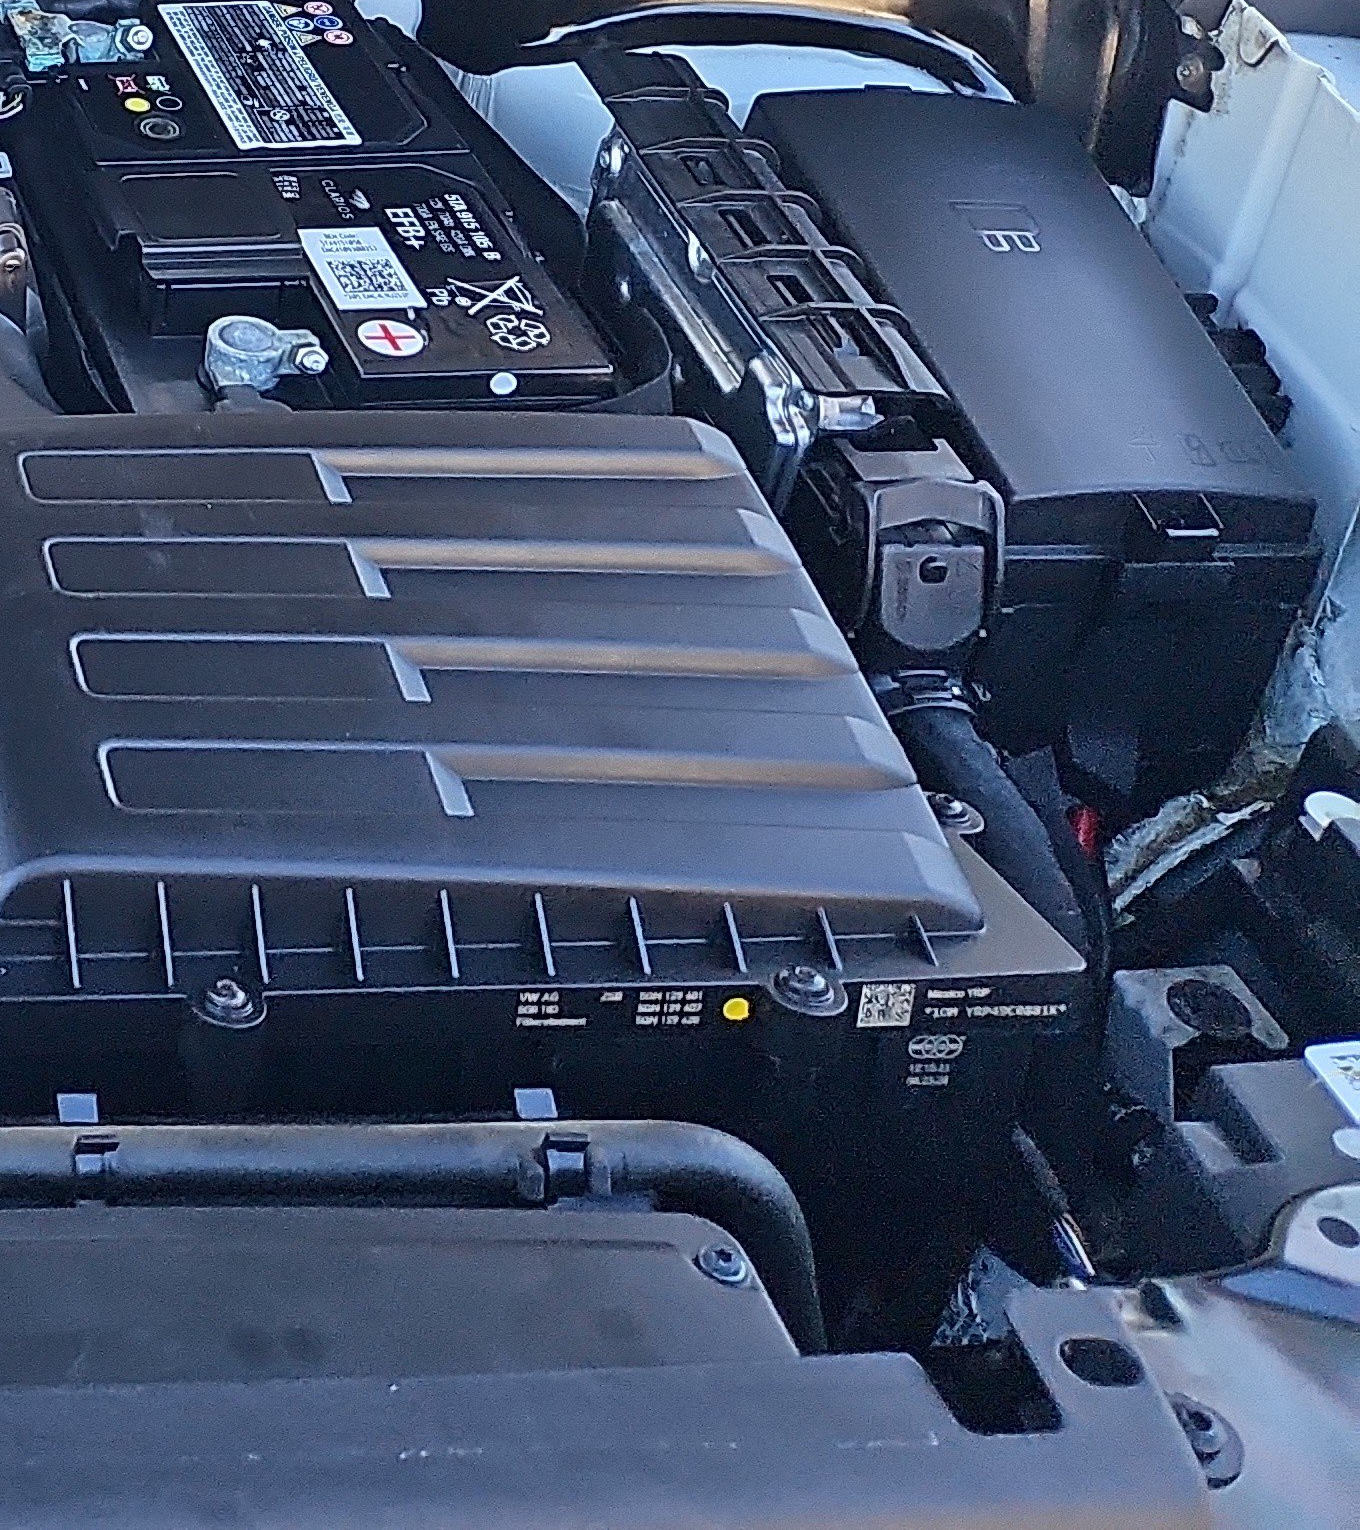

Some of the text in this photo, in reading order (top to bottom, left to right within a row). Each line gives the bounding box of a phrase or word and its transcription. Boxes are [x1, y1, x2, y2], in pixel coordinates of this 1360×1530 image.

[321, 179, 354, 220] CLARIOS
[384, 207, 426, 250] EFB+
[457, 211, 480, 230] 915
[469, 230, 494, 250] 105
[426, 288, 451, 307] Pb
